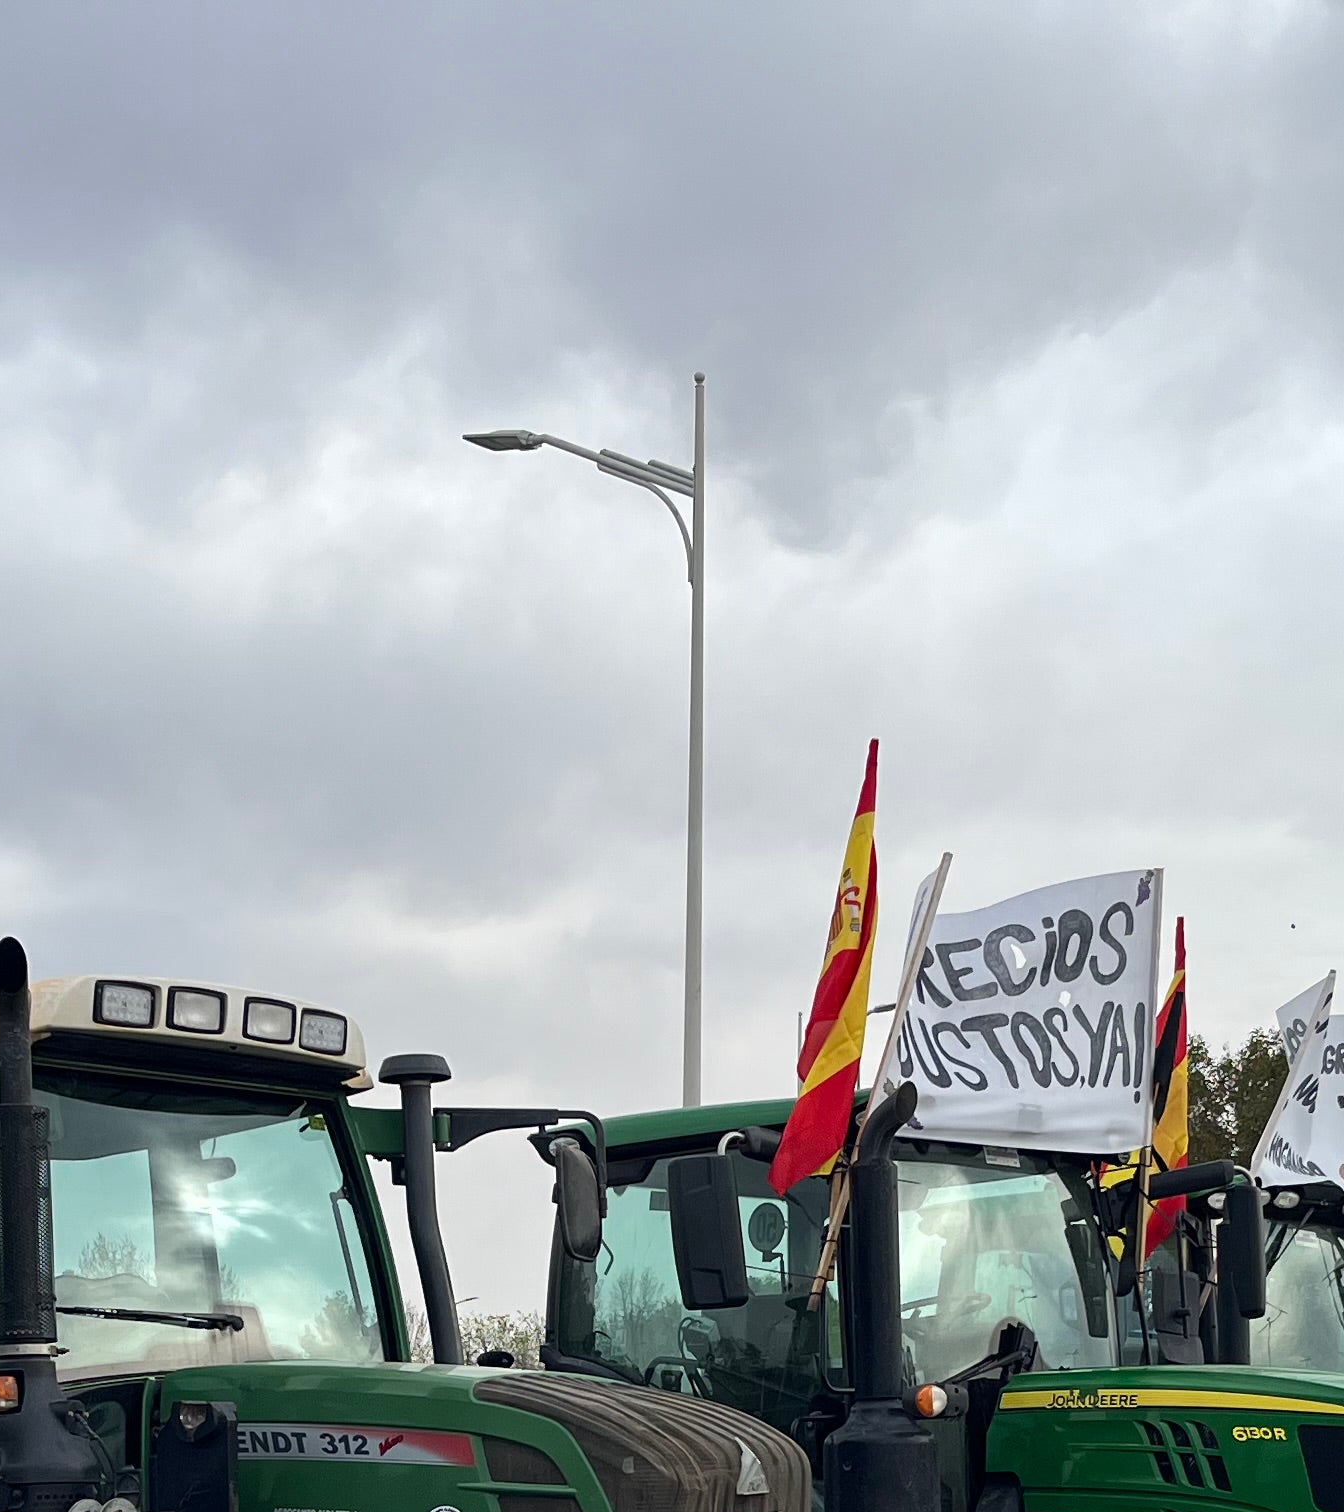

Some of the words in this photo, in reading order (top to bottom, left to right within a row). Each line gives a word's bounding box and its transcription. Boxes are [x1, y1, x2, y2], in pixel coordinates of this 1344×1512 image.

[913, 901, 1134, 1009] RECiOS
[237, 1431, 307, 1454] ENDT
[319, 1432, 370, 1455] 312
